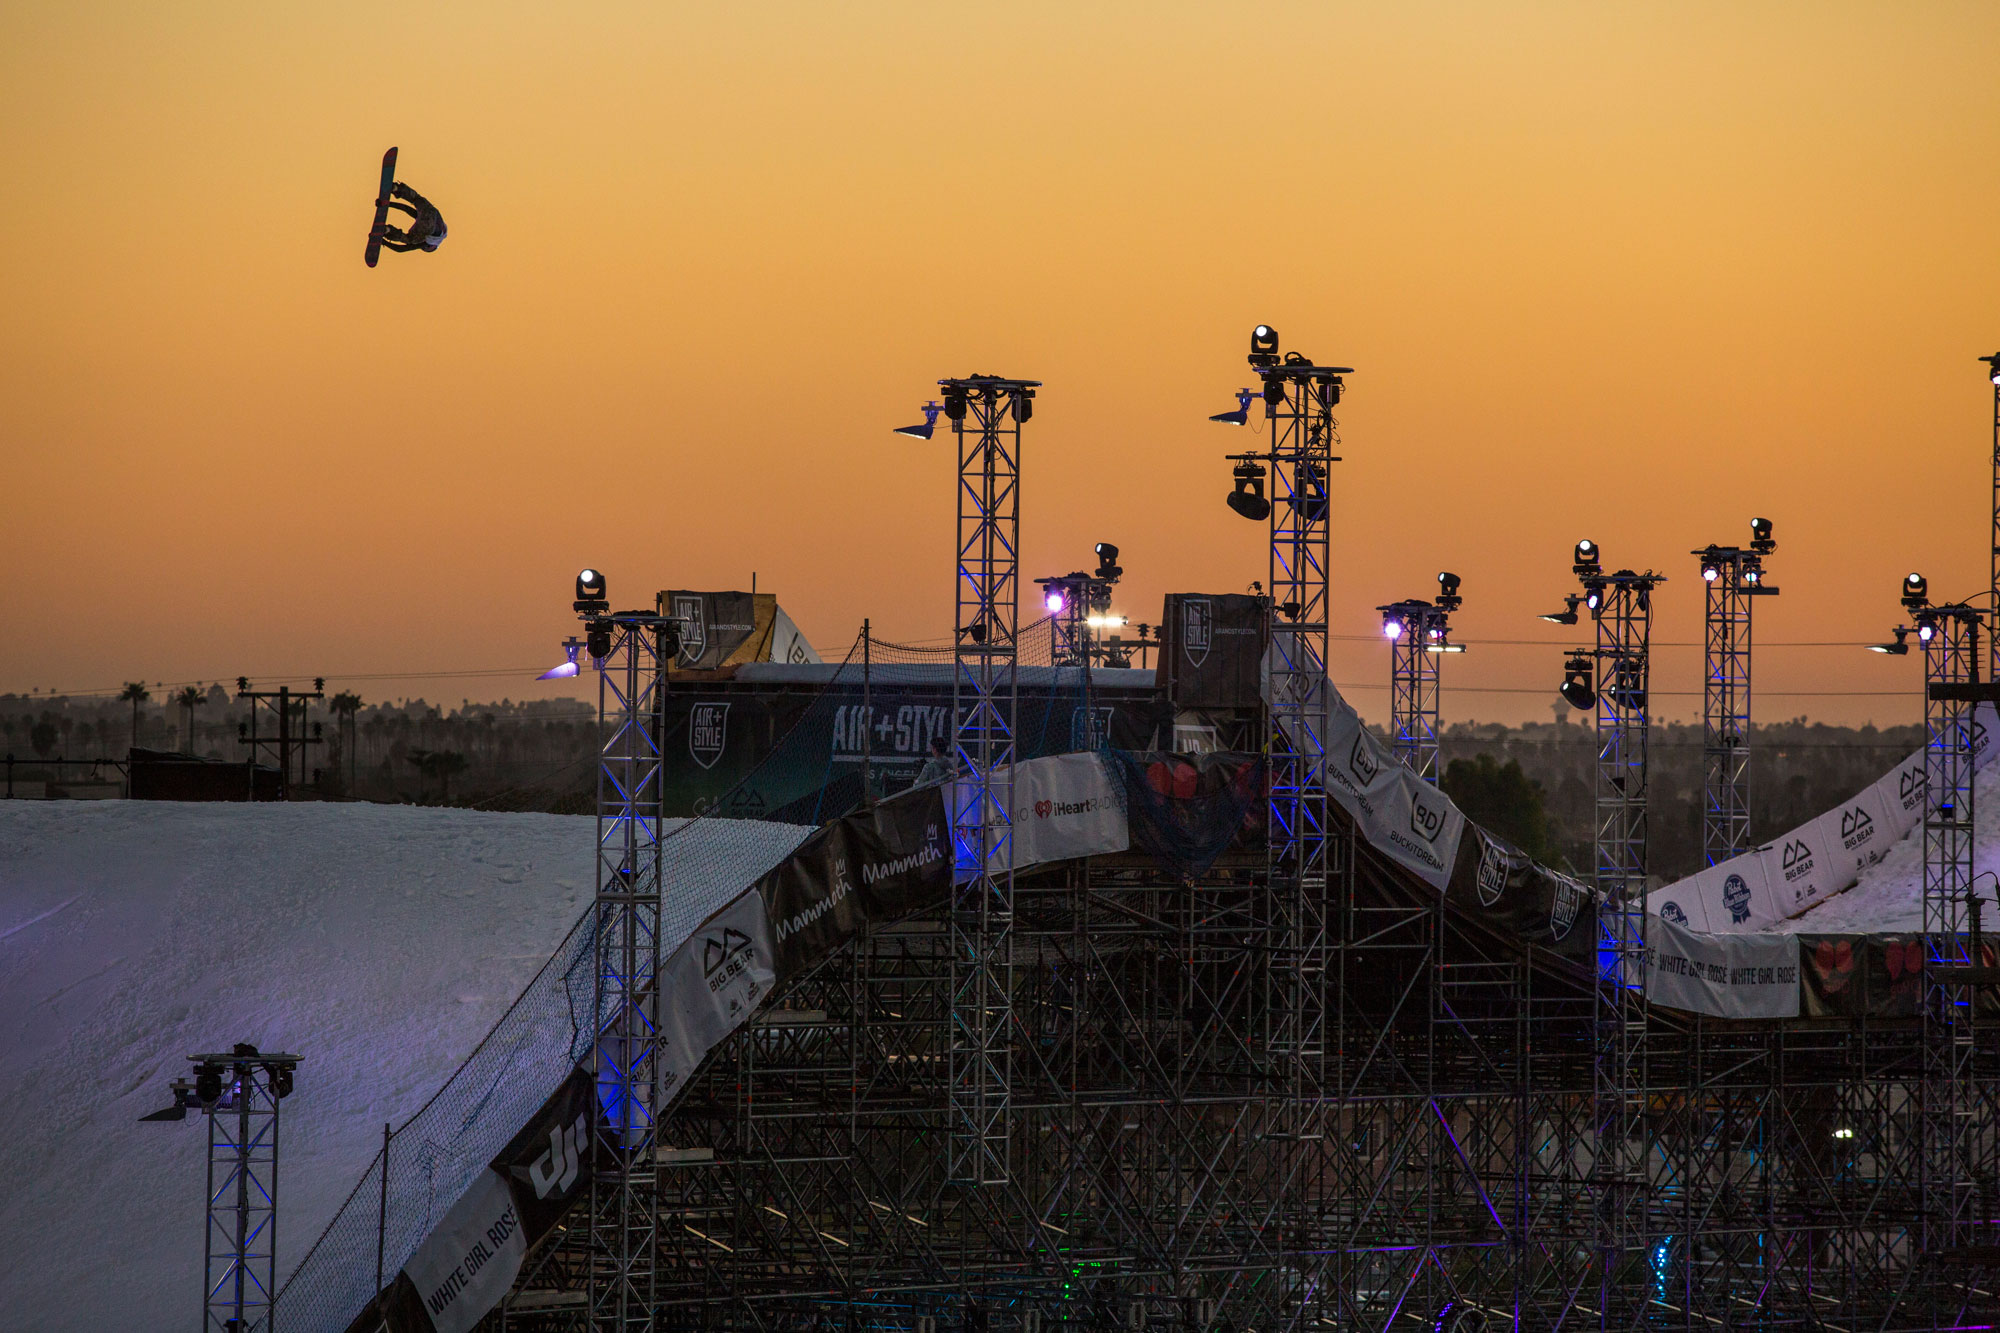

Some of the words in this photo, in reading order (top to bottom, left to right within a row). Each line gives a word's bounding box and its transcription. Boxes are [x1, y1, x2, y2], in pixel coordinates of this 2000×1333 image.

[681, 621, 702, 640] STYLE
[1187, 626, 1208, 646] STYLE
[694, 726, 722, 747] STYLE
[1903, 796, 1915, 810] BIG
[1415, 804, 1438, 832] BD
[1844, 838, 1857, 850] BIG
[1856, 826, 1875, 843] BEAR
[862, 843, 943, 885] Mammoth
[1785, 869, 1797, 881] BIG
[1796, 860, 1814, 875] BEAR
[1480, 866, 1502, 891] STYLE
[776, 878, 852, 943] Mammoth
[1555, 901, 1576, 924] STYLE
[709, 972, 727, 993] BIG
[727, 948, 754, 977] BEAR
[1659, 953, 1690, 975] WHITE
[1688, 960, 1707, 979] GIRL
[1707, 963, 1728, 984] ROSÉ
[1730, 967, 1757, 985] WHITE
[1758, 967, 1776, 984] GIRL
[1777, 962, 1796, 984] ROSÉ
[427, 1265, 469, 1316] WHITE
[463, 1240, 494, 1277] GIRL
[486, 1203, 519, 1249] ROSÉ
